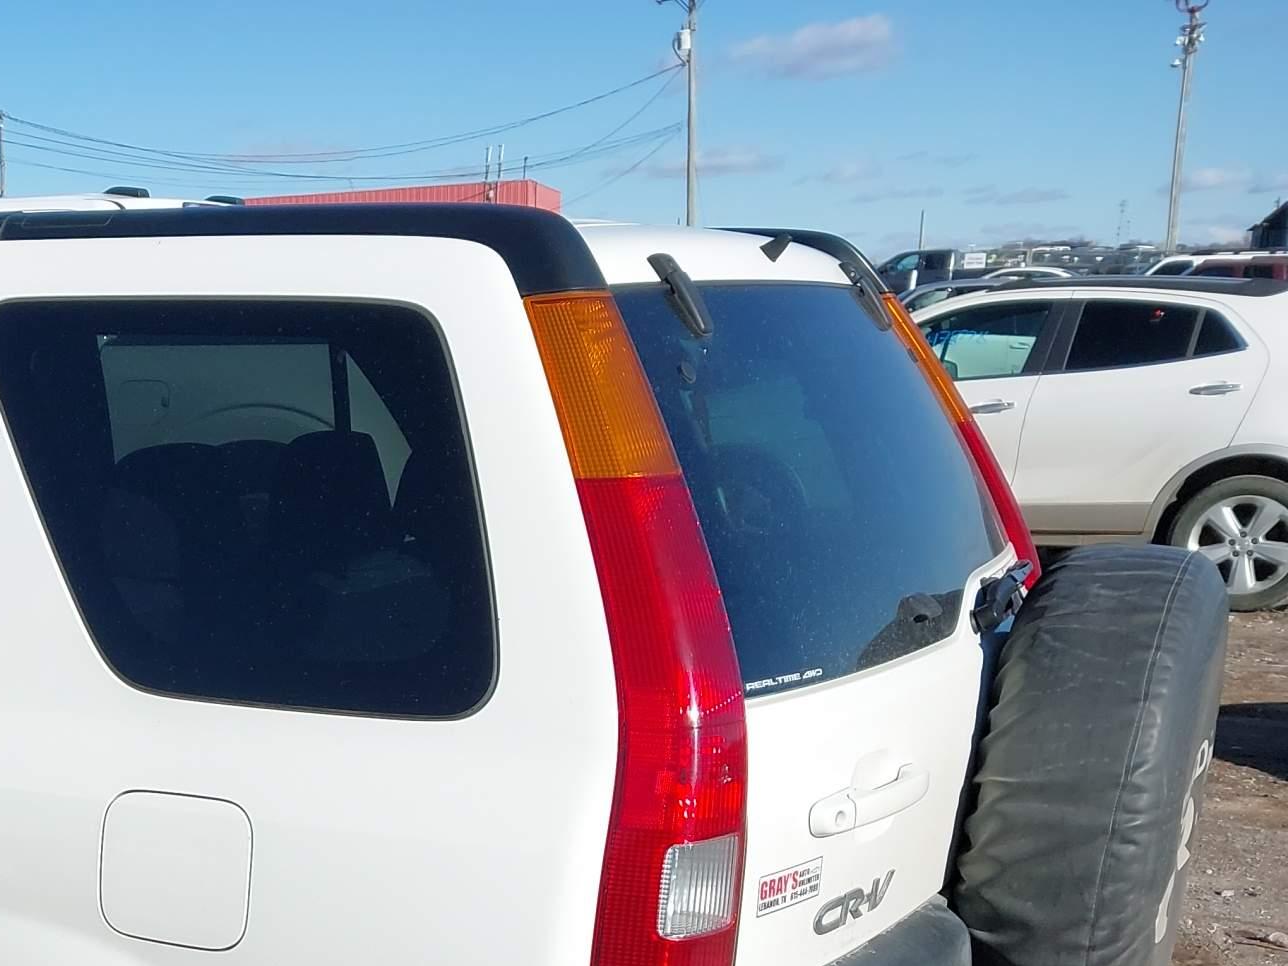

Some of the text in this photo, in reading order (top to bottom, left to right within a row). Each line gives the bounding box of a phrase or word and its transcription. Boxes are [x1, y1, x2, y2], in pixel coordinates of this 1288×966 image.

[760, 870, 799, 901] GRAY'S
[798, 868, 810, 878] AUTO
[813, 869, 896, 936] CR-V
